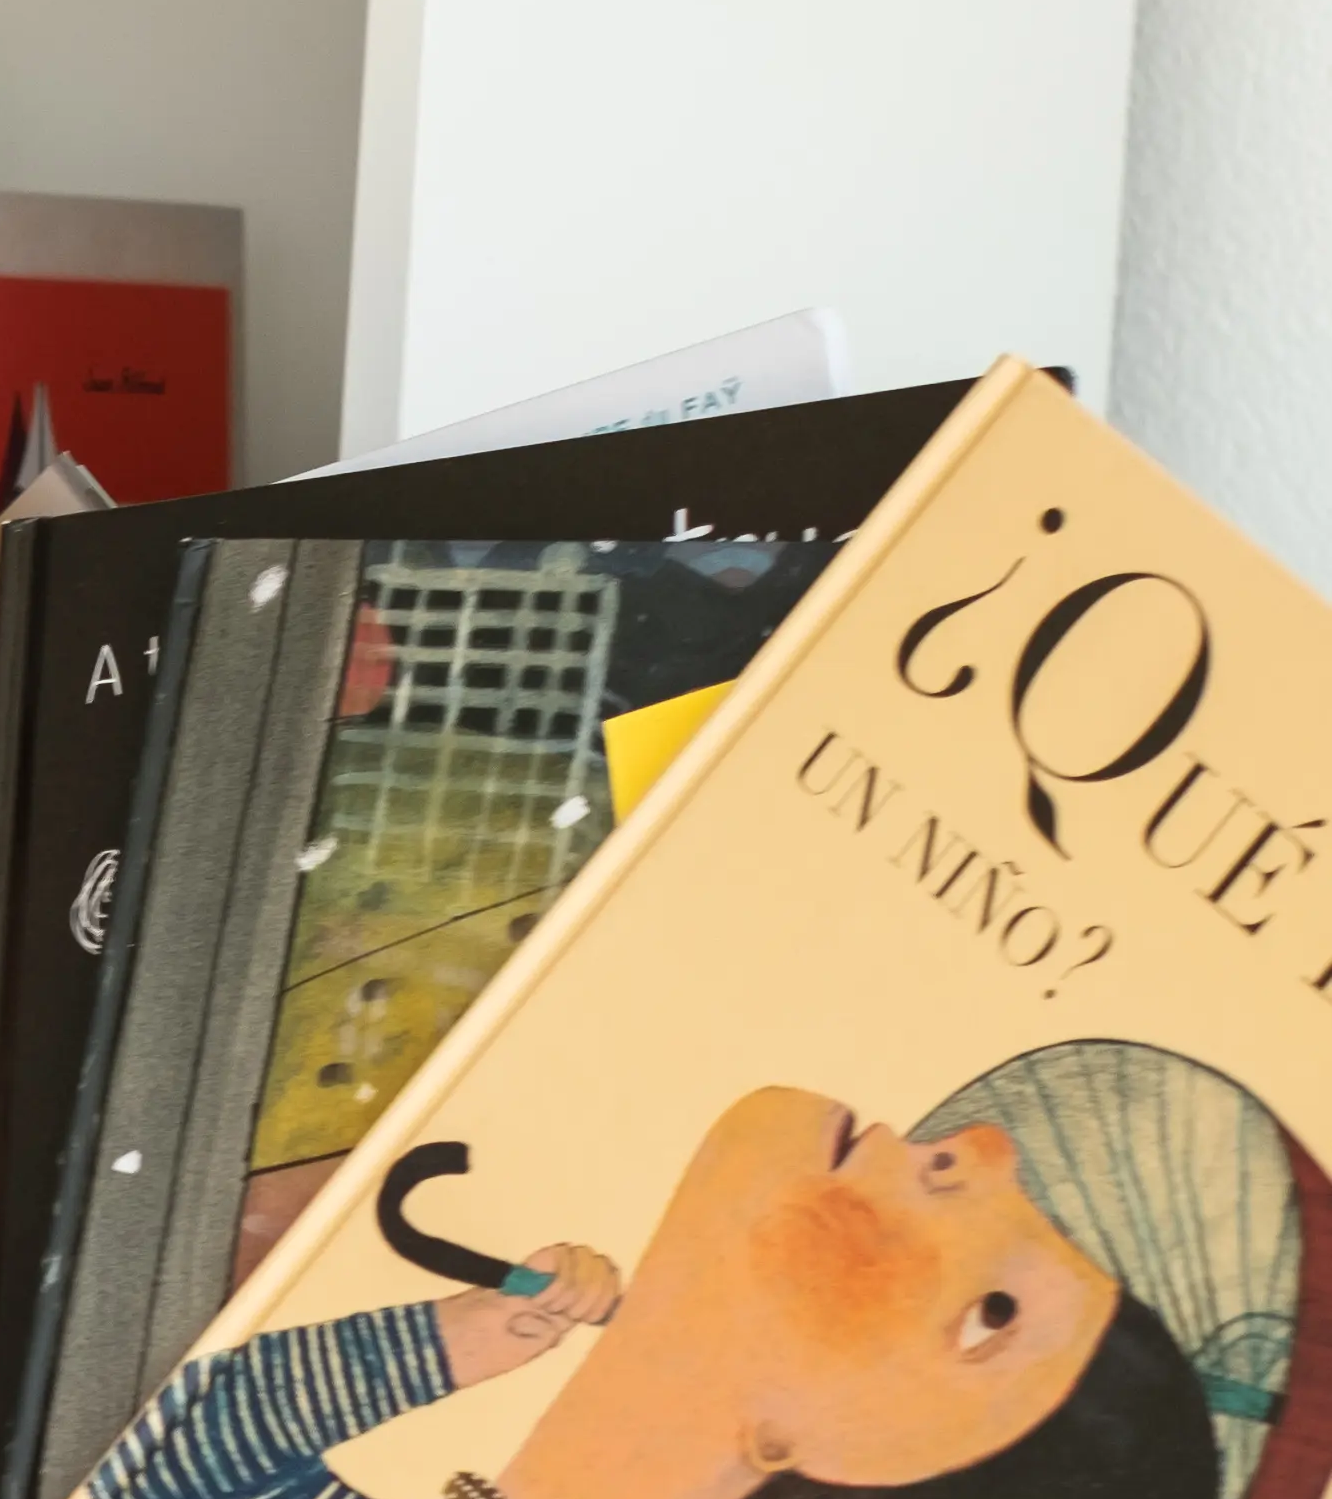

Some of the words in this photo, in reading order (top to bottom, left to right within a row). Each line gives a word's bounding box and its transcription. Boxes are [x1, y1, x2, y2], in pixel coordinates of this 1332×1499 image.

[85, 642, 123, 706] A
[894, 505, 1329, 938] ¿QUÉ
[796, 725, 905, 835] UN
[888, 812, 1116, 1002] NIÑO?
